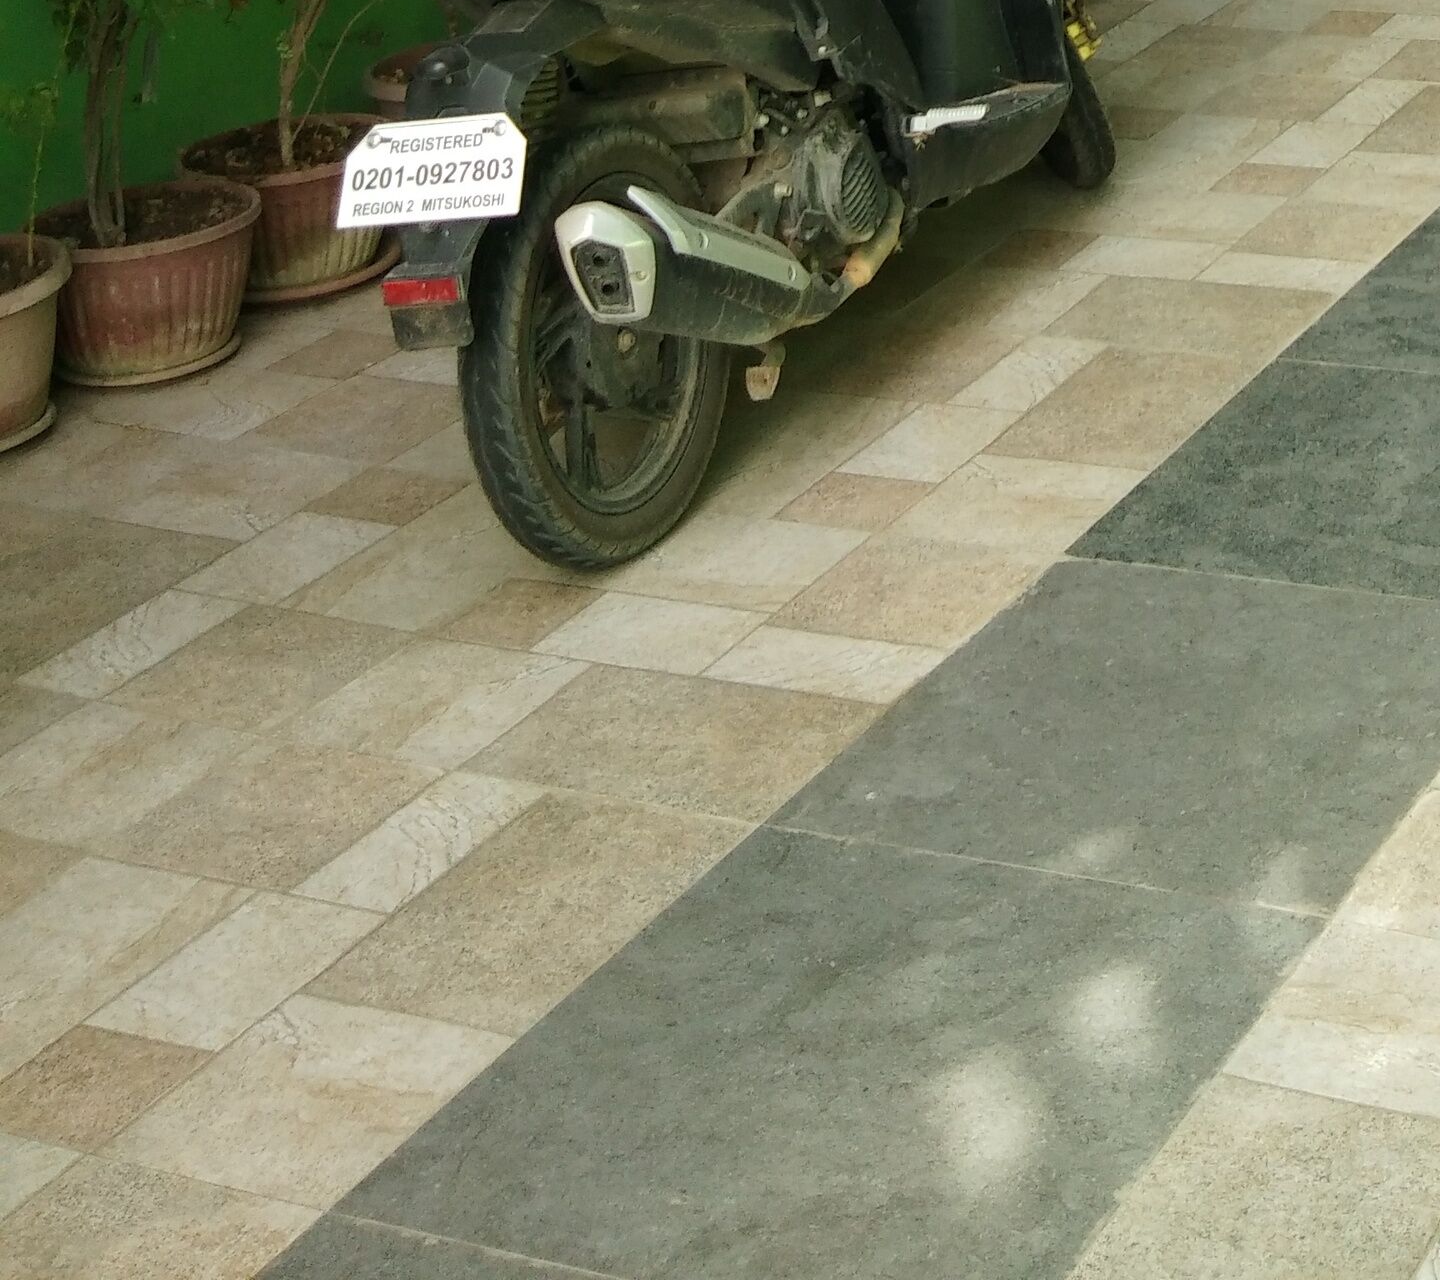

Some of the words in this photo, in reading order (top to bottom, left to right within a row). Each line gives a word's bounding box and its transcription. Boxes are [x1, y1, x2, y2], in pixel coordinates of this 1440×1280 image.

[389, 133, 484, 155] REGISTERED
[352, 156, 514, 191] 0201-0927803
[352, 201, 404, 218] REGION
[406, 200, 415, 213] 2
[421, 192, 505, 212] MITSUKOSHI
